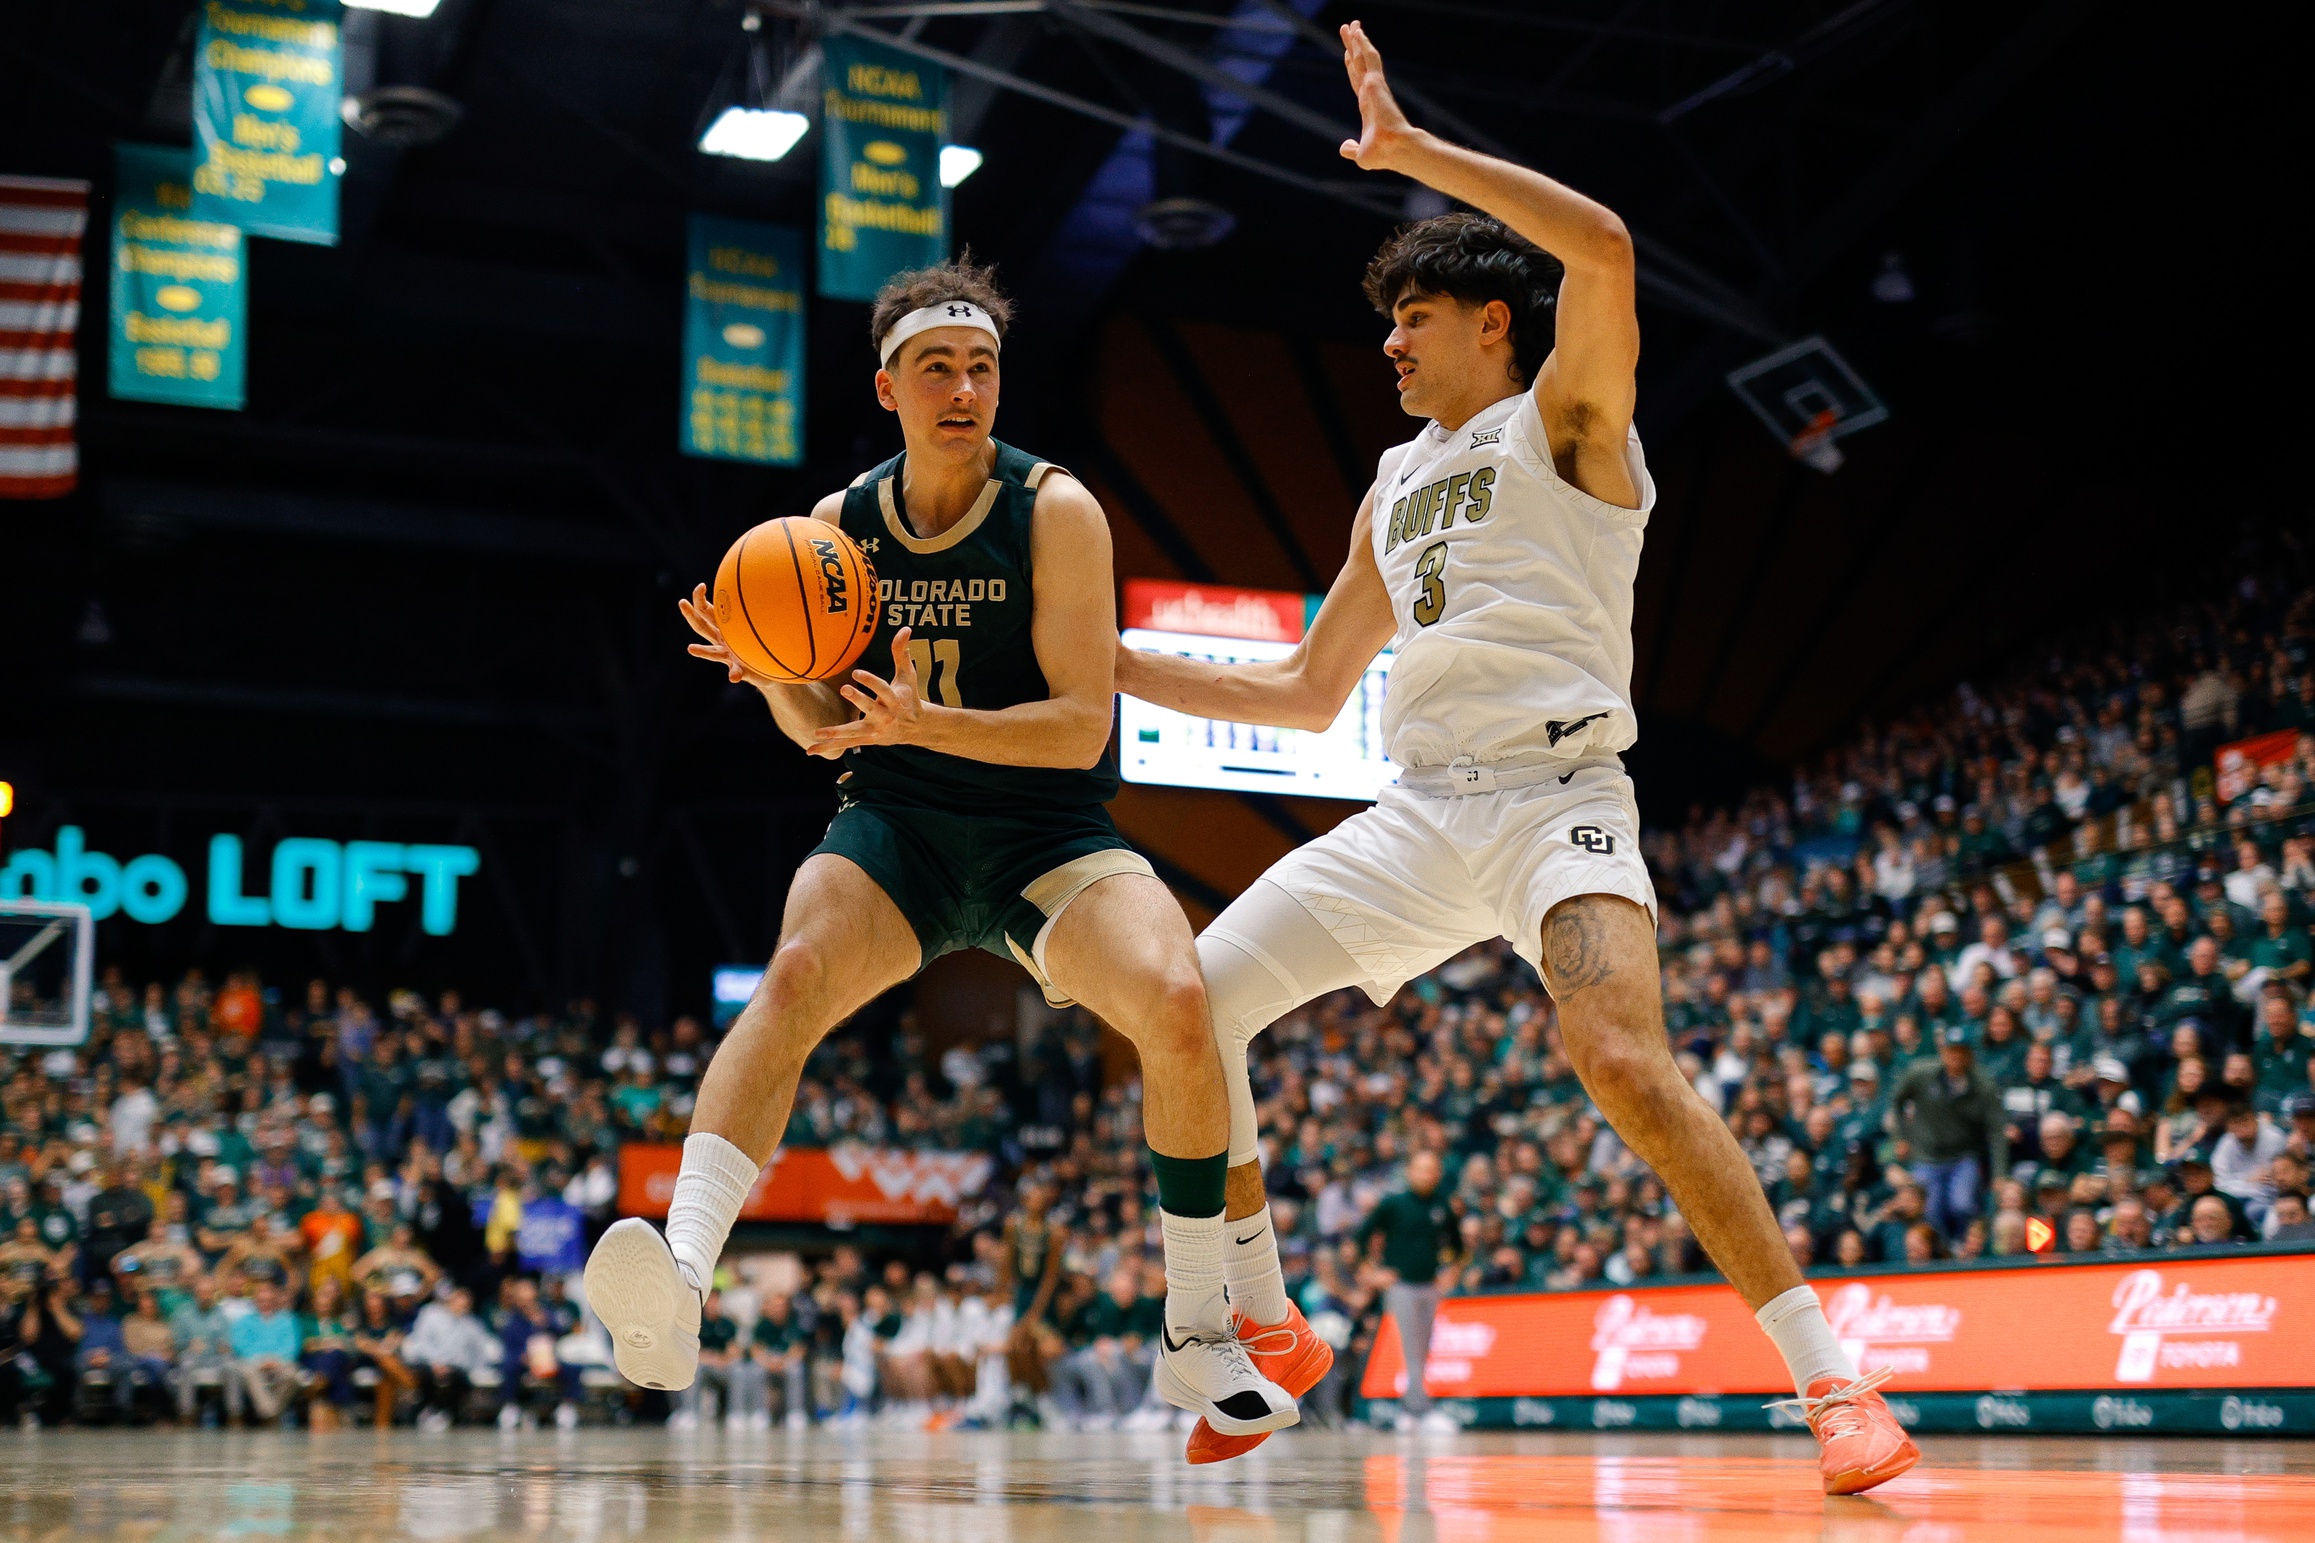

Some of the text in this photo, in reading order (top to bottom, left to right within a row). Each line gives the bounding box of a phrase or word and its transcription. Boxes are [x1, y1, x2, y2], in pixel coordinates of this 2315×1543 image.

[1385, 466, 1496, 555] BUFFS
[810, 539, 848, 614] NCAA
[879, 579, 1006, 602] OLORADO
[888, 604, 971, 626] STATE
[1414, 541, 1448, 627] 3
[209, 833, 479, 936] LOFT
